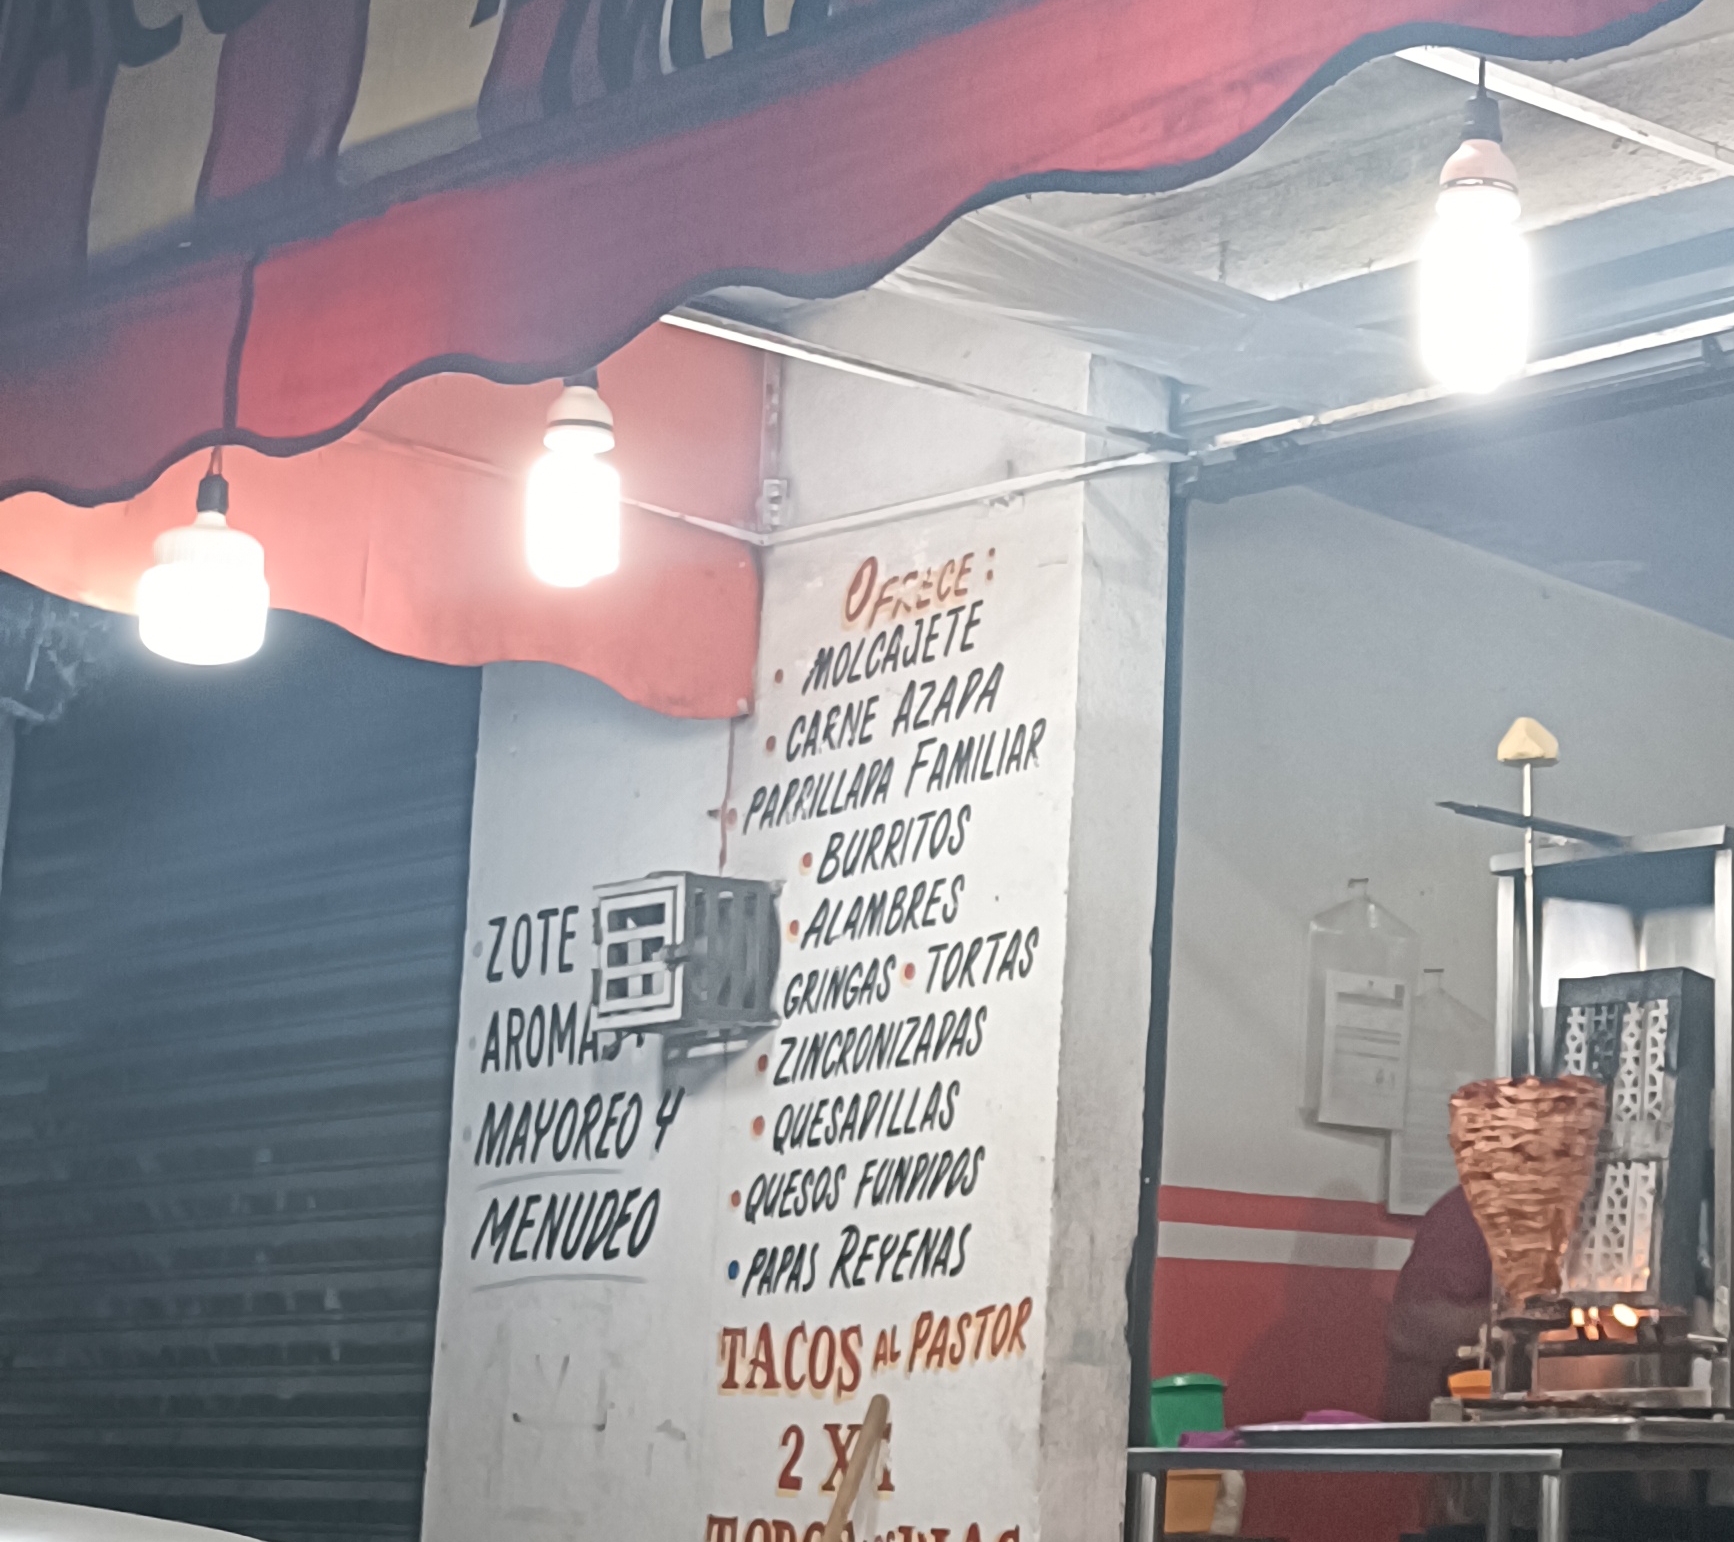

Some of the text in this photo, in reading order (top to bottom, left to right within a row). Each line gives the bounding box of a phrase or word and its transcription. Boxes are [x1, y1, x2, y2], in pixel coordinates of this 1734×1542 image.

[801, 599, 984, 696] MOLCAJETE
[785, 661, 1005, 762] CARNE AZADA
[742, 717, 1047, 836] PARRILLADA FAMILIAR
[816, 803, 972, 885] BURRITOS
[486, 904, 580, 983] ZOTE
[800, 873, 966, 951] ALAMBRES
[783, 925, 1040, 1019] GRINGAS TORTAS
[772, 1004, 988, 1087] ZINCRONIZADAS
[473, 1086, 686, 1167] MAYOREO Y
[772, 1079, 961, 1156] QUESADILLAS
[743, 1144, 986, 1225] QUESOS FUNDIDOS
[470, 1186, 661, 1265] MENUDEO
[741, 1222, 973, 1298] PAPAS REYENAS
[720, 1296, 1034, 1398] TACOS AL PASTOR
